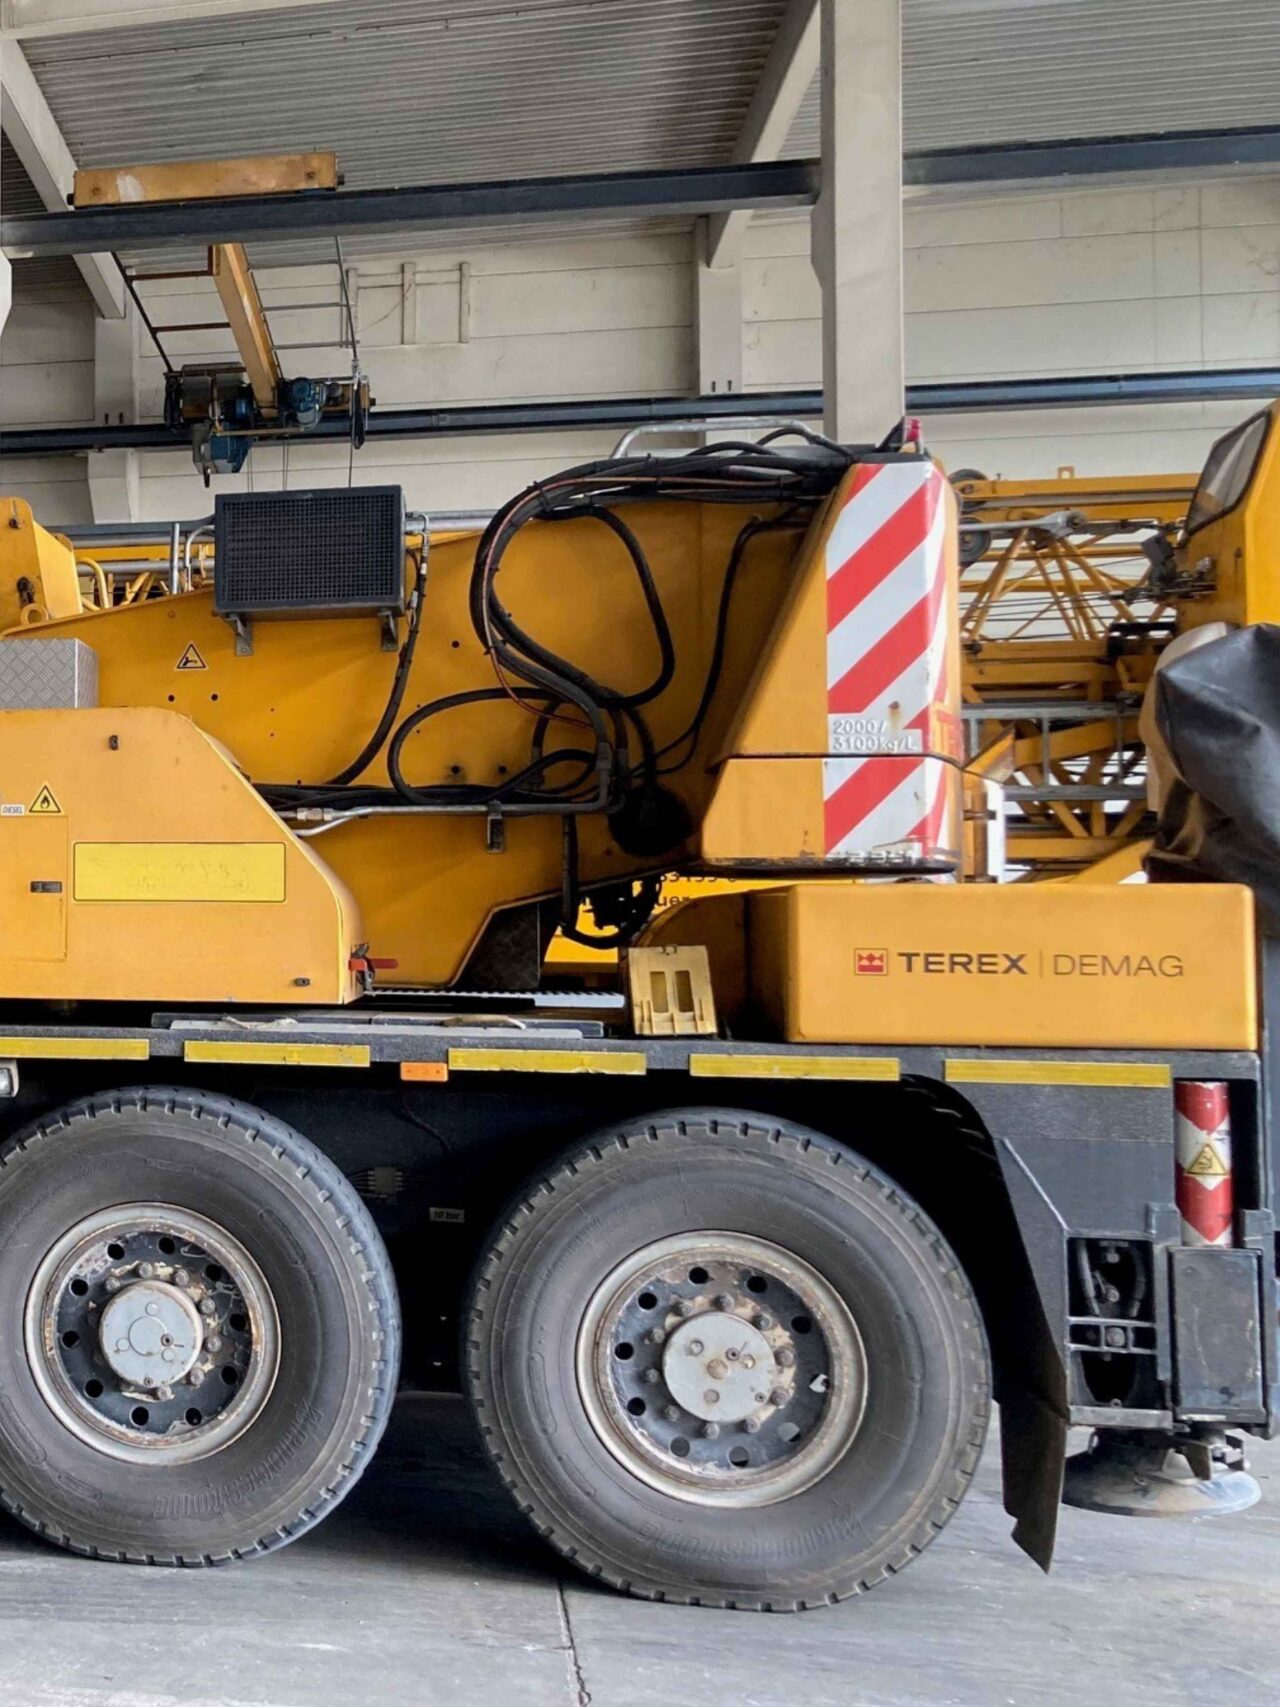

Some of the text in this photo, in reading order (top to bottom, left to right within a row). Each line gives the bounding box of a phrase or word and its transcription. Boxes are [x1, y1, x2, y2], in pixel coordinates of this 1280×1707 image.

[2, 805, 23, 814] DIESEL
[897, 951, 1184, 978] TEREX DEMAG
